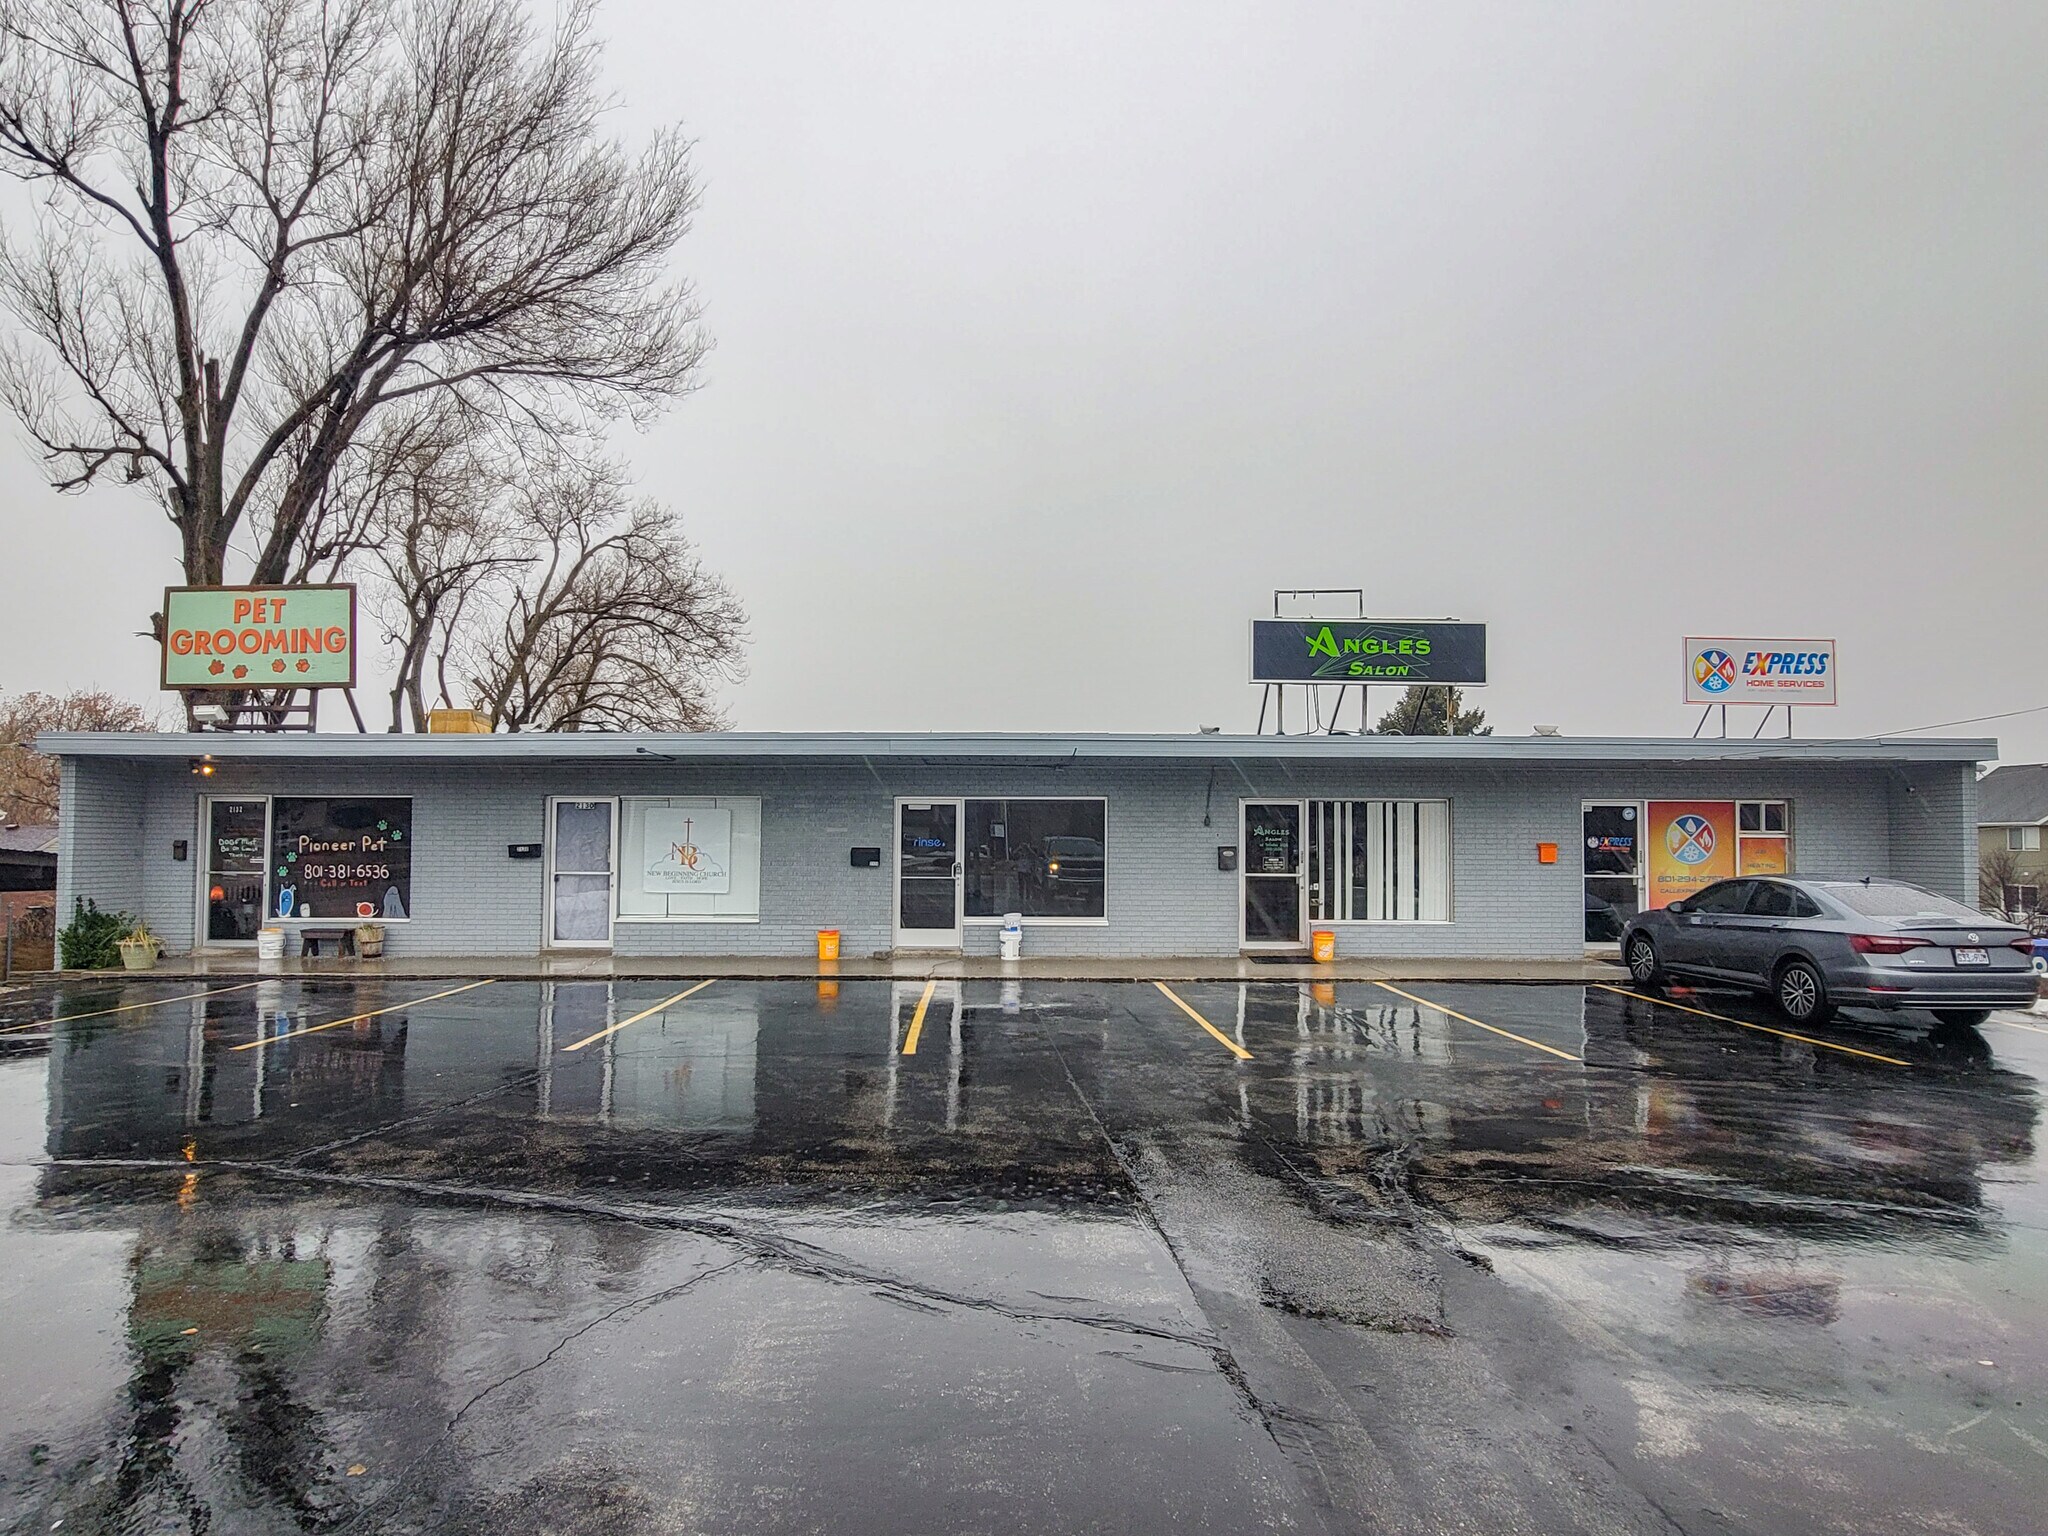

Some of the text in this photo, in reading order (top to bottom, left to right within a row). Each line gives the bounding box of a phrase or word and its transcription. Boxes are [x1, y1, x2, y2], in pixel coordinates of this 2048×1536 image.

[233, 597, 287, 624] PET
[170, 626, 347, 655] GROOMING
[1742, 652, 1830, 676] EXPRESS
[1746, 679, 1825, 688] HOME SERVICES
[575, 802, 595, 810] 2130
[298, 835, 388, 854] Pioneer Pet
[1599, 837, 1633, 847] EXPRESS
[304, 863, 390, 880] 801-381-6536
